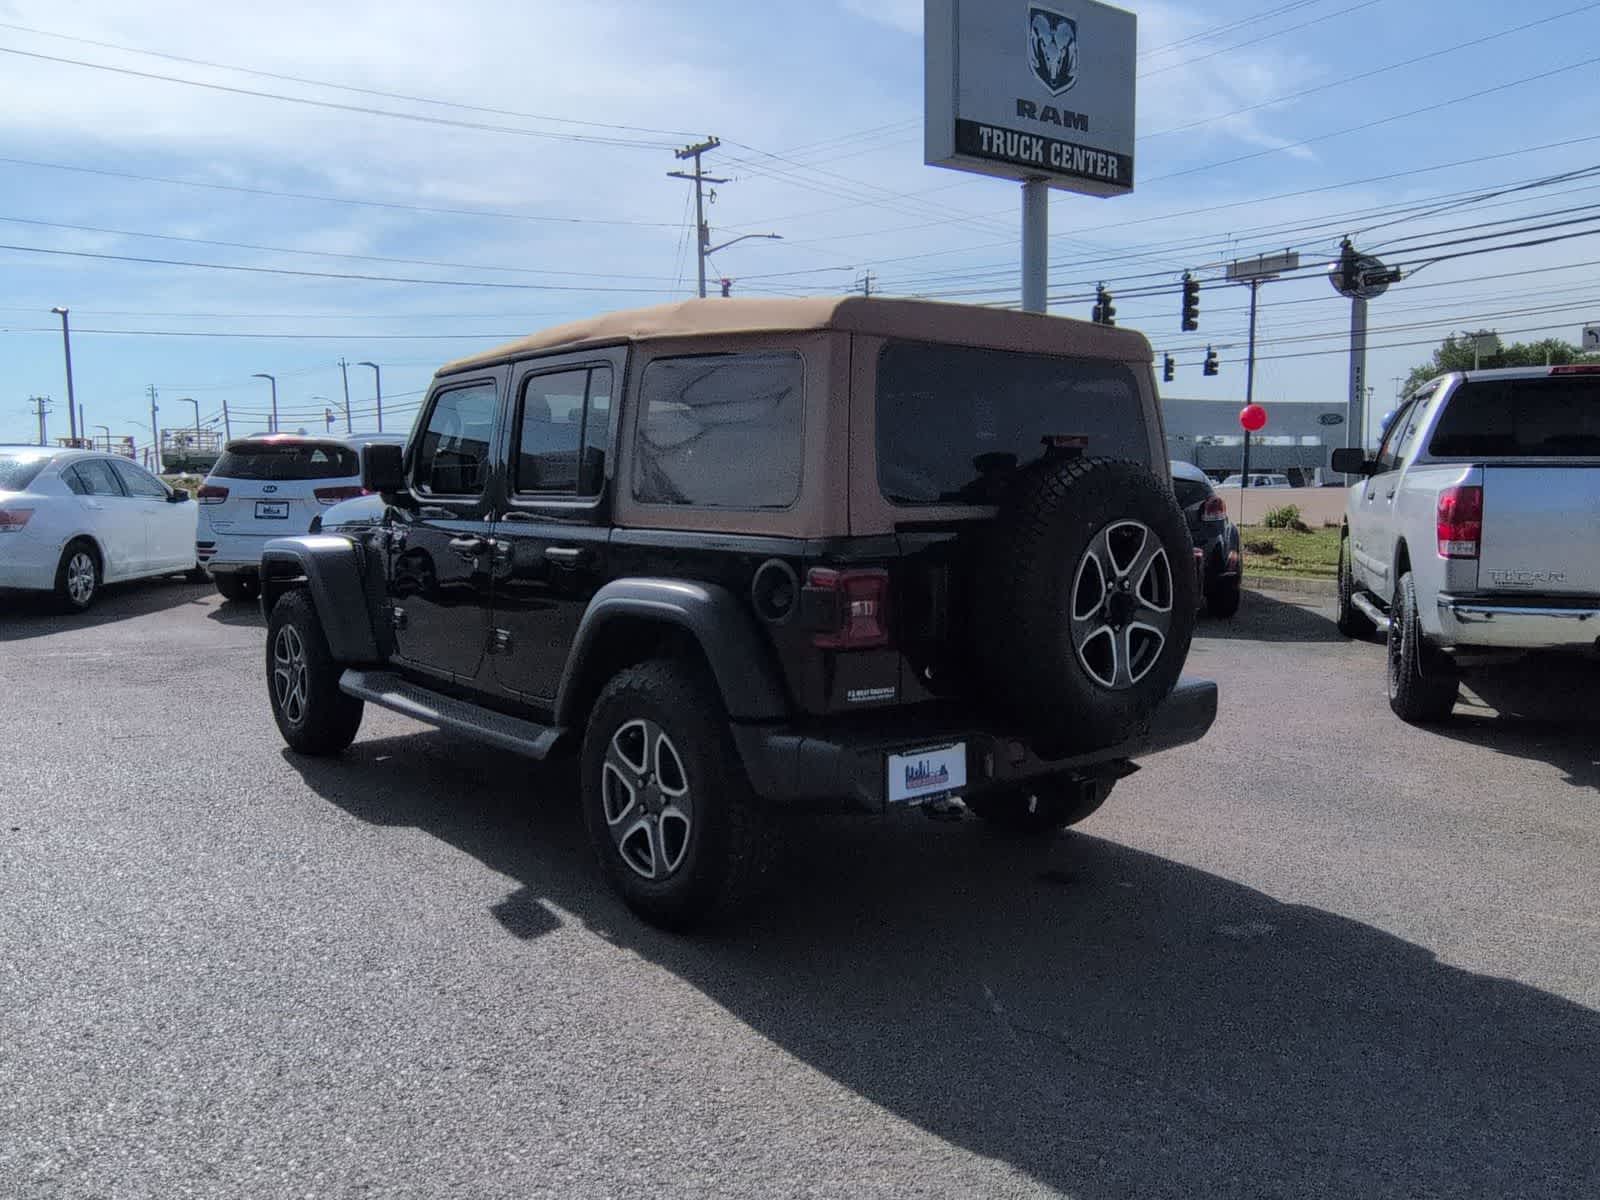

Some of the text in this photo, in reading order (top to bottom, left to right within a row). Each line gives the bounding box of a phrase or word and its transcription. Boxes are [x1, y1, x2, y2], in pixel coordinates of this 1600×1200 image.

[1016, 98, 1088, 133] RAM
[979, 127, 1118, 178] TRUCK CENTER
